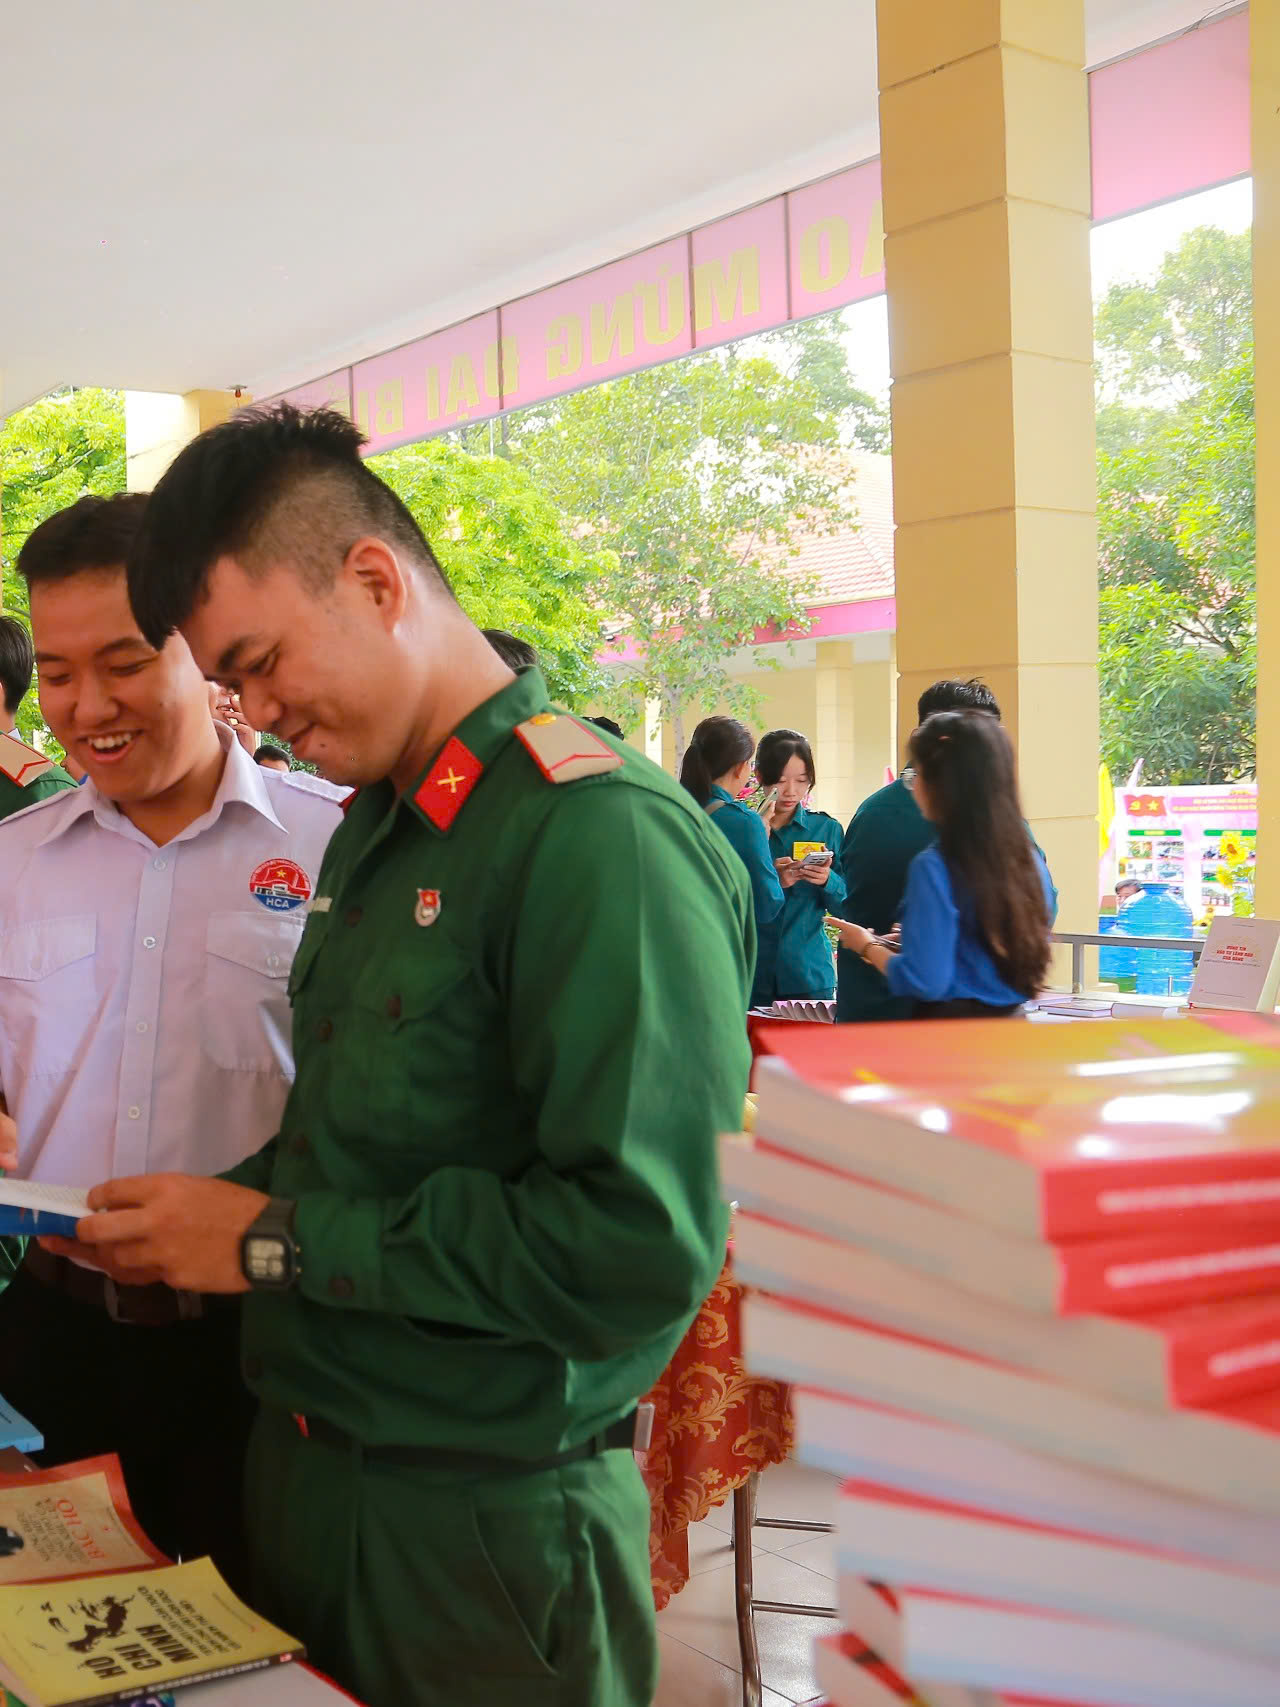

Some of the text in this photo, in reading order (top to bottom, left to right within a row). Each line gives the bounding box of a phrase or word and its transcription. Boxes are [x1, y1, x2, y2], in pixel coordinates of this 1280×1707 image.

[266, 898, 290, 908] HCA
[107, 1641, 163, 1673] CHÍ
[133, 1621, 200, 1666] MINH
[70, 1654, 128, 1683] HỒ
